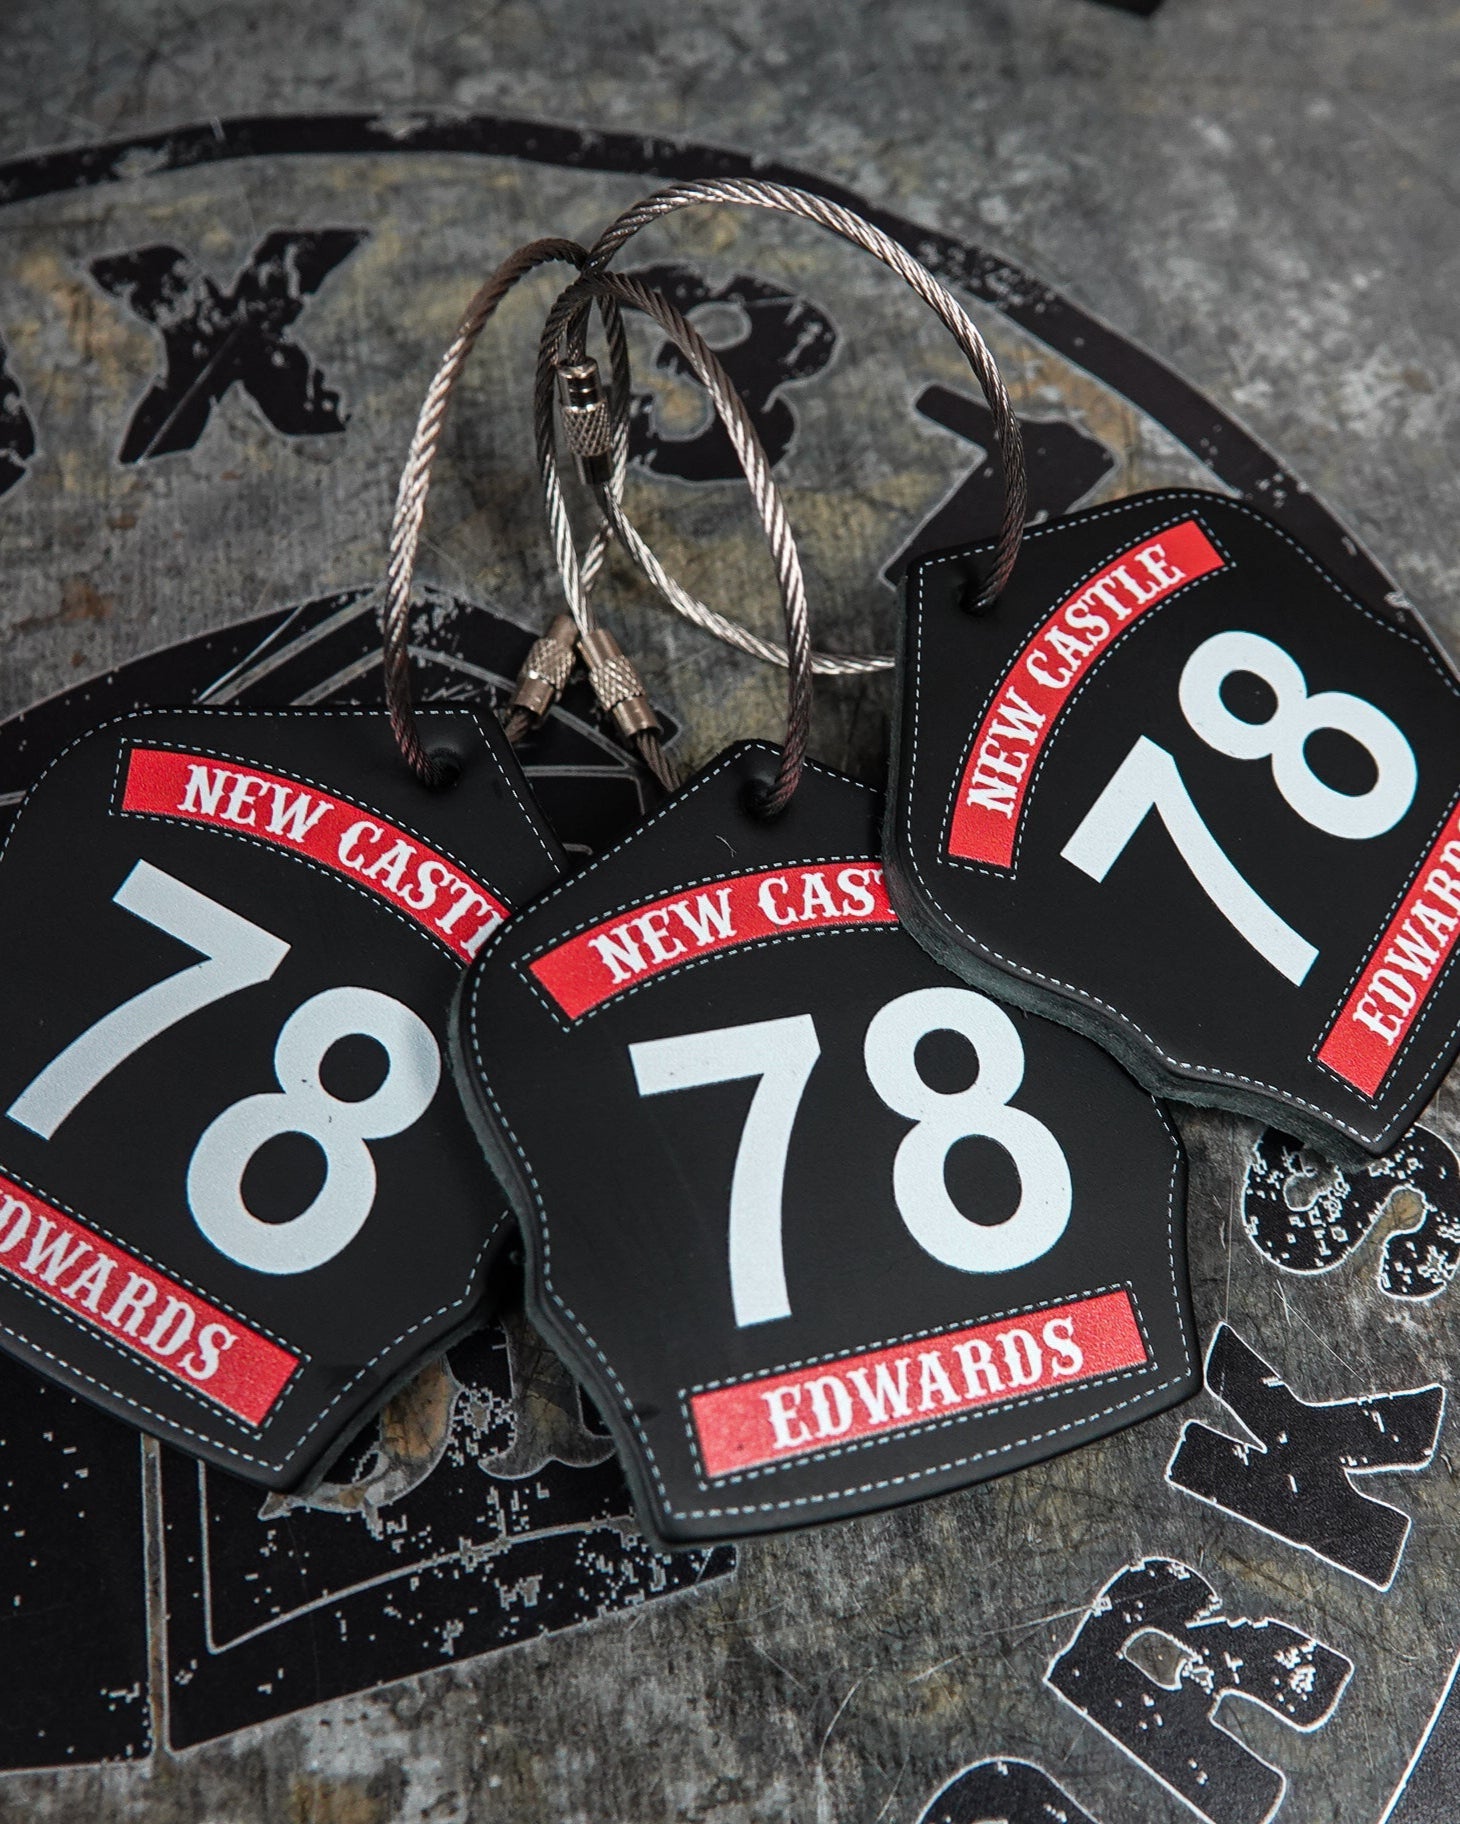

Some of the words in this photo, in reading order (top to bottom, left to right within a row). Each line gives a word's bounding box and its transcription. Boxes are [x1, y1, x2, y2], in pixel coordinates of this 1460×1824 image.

[967, 686, 1046, 818] NEW
[1031, 544, 1186, 690] CASTLE
[177, 764, 335, 843] NEW
[1060, 631, 1418, 986] 78
[588, 888, 737, 984] NEW
[758, 868, 893, 926] CAS
[1353, 820, 1460, 1046] EDWAR
[6, 858, 441, 1275] 78
[629, 987, 1073, 1328] 78
[0, 1190, 239, 1380] DWARDS
[760, 1317, 1084, 1450] EDWARDS
